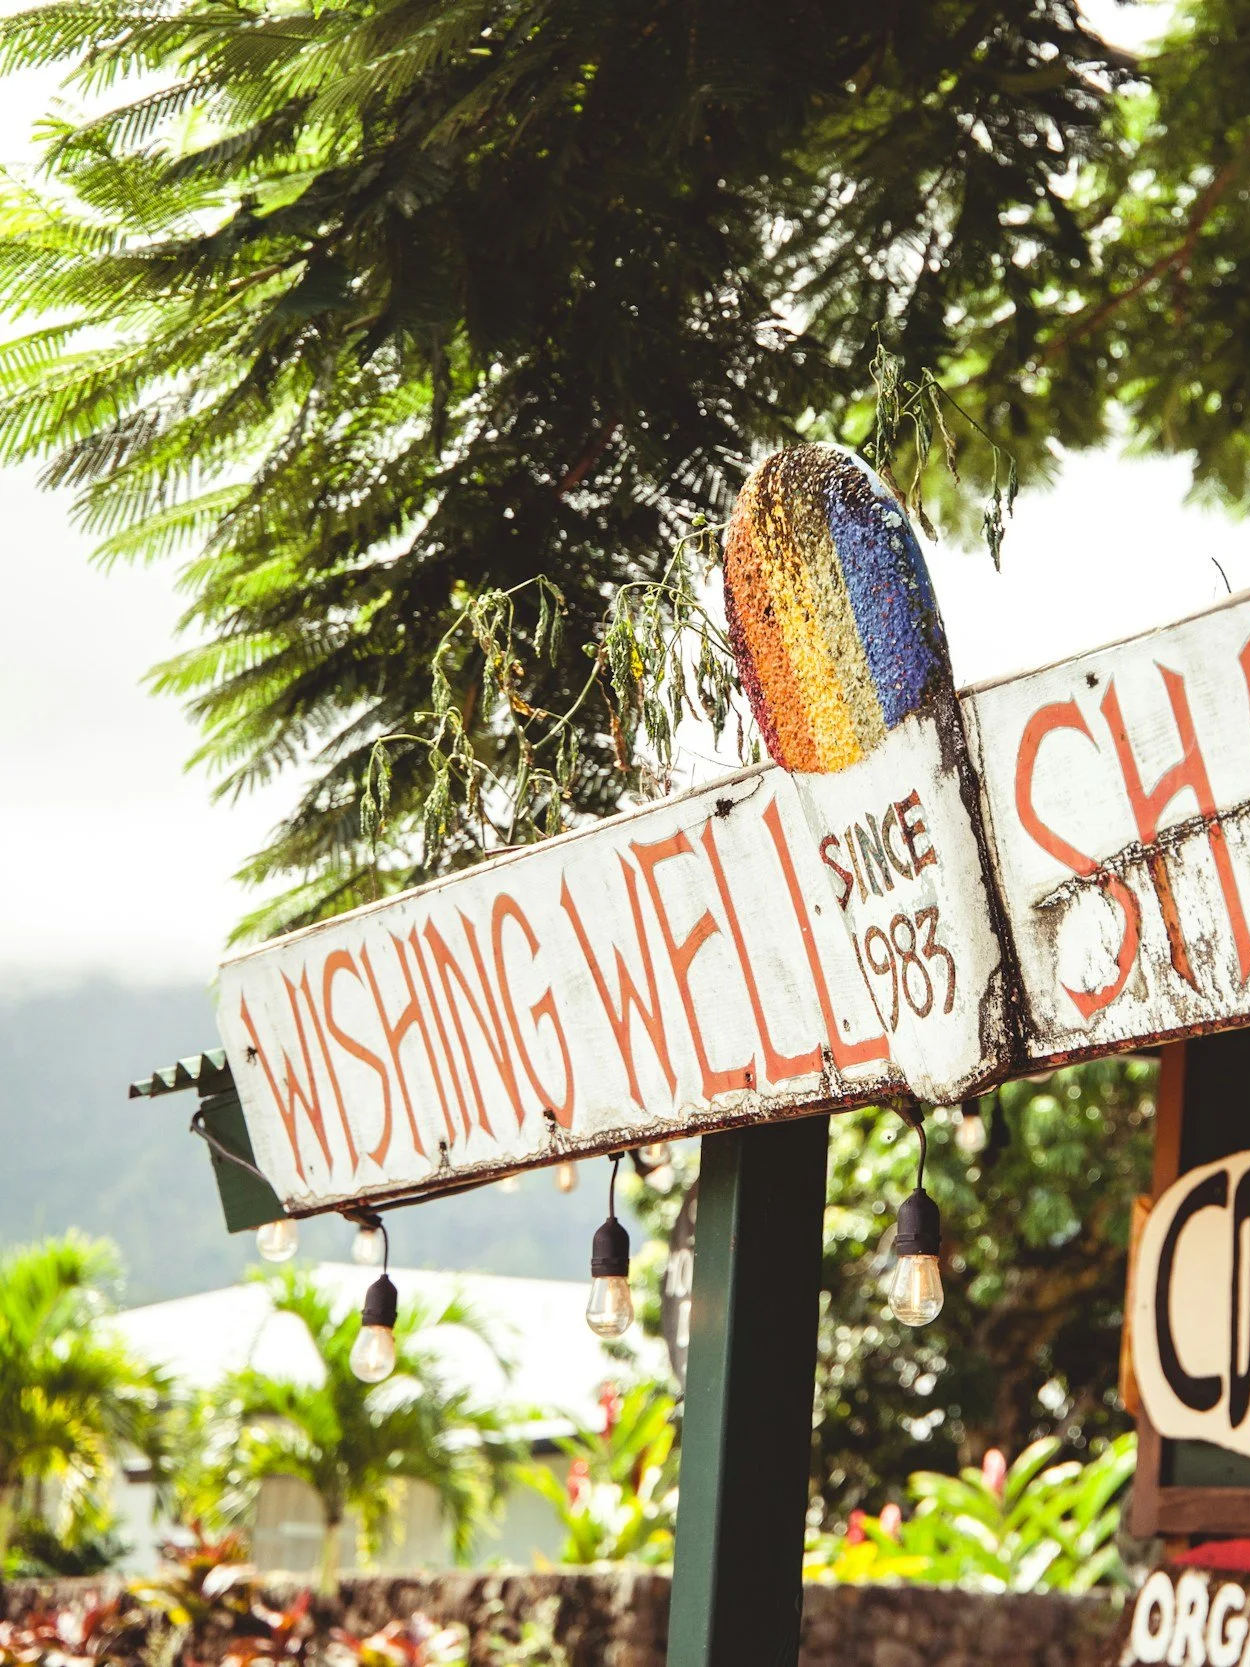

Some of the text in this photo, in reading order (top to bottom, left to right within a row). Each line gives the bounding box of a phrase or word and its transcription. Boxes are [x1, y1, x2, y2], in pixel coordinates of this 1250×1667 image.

[819, 789, 938, 911] SINCE
[241, 797, 890, 1182] WISHING WELL
[852, 905, 956, 1033] 1983
